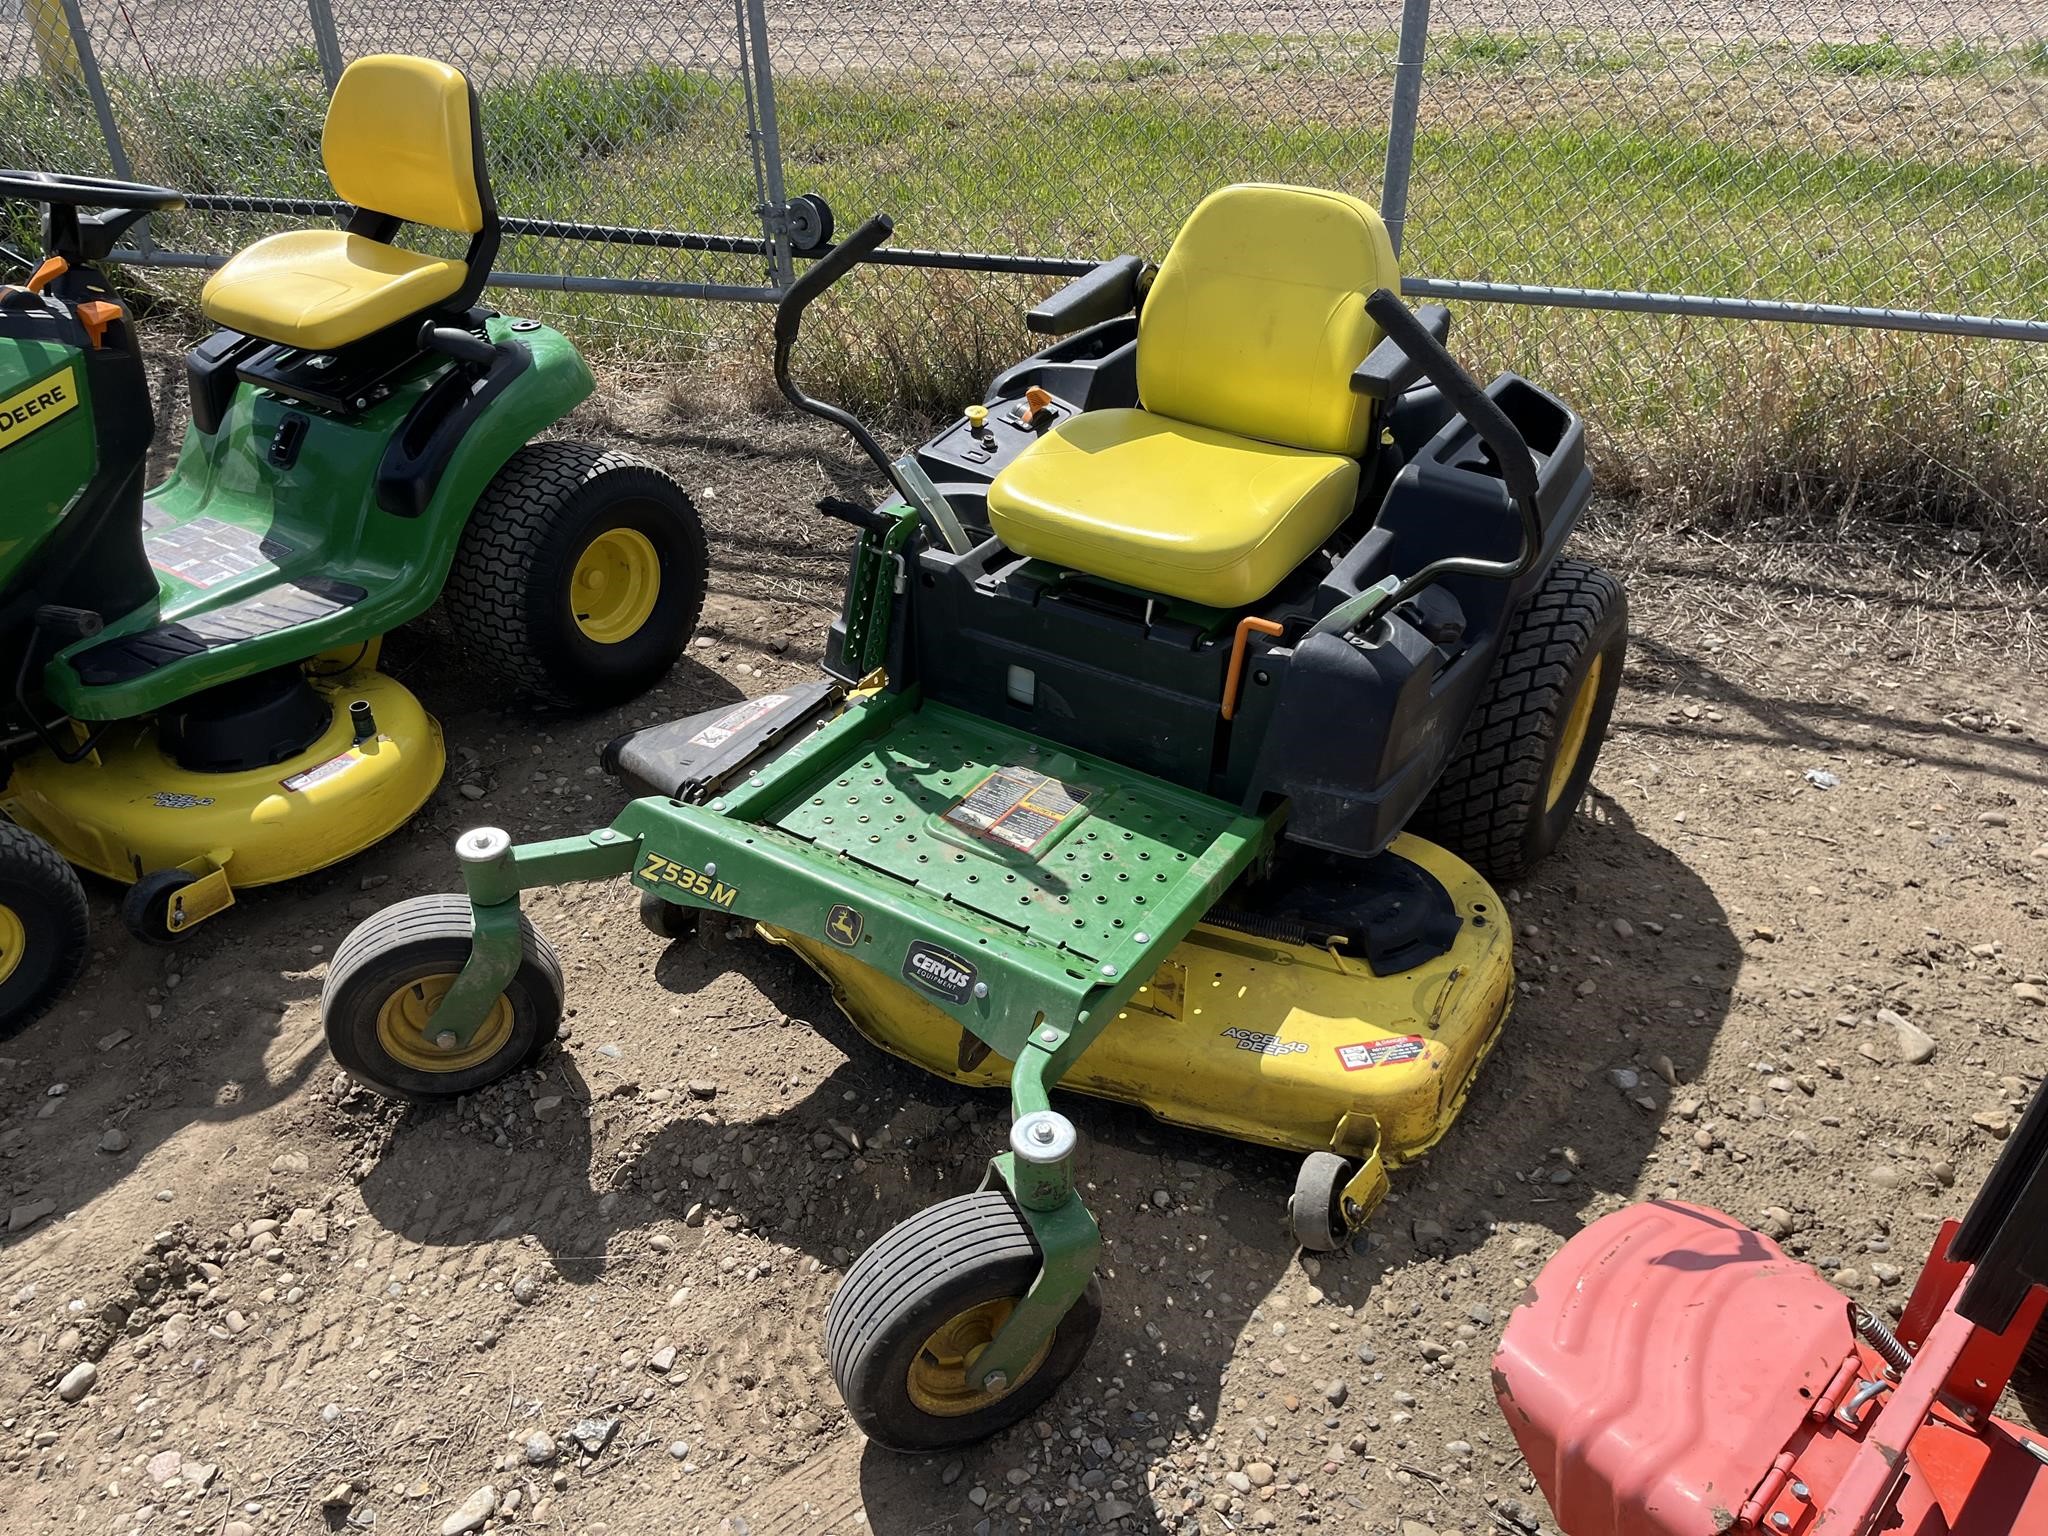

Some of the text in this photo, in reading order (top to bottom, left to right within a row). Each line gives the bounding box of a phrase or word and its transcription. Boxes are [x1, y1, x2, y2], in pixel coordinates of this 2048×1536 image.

[0, 385, 66, 432] DEERE
[912, 953, 970, 988] CERVUS
[916, 969, 957, 991] EQUIPMENT
[1221, 1027, 1309, 1053] ACCEL 48
[1236, 1039, 1290, 1056] DEEP
